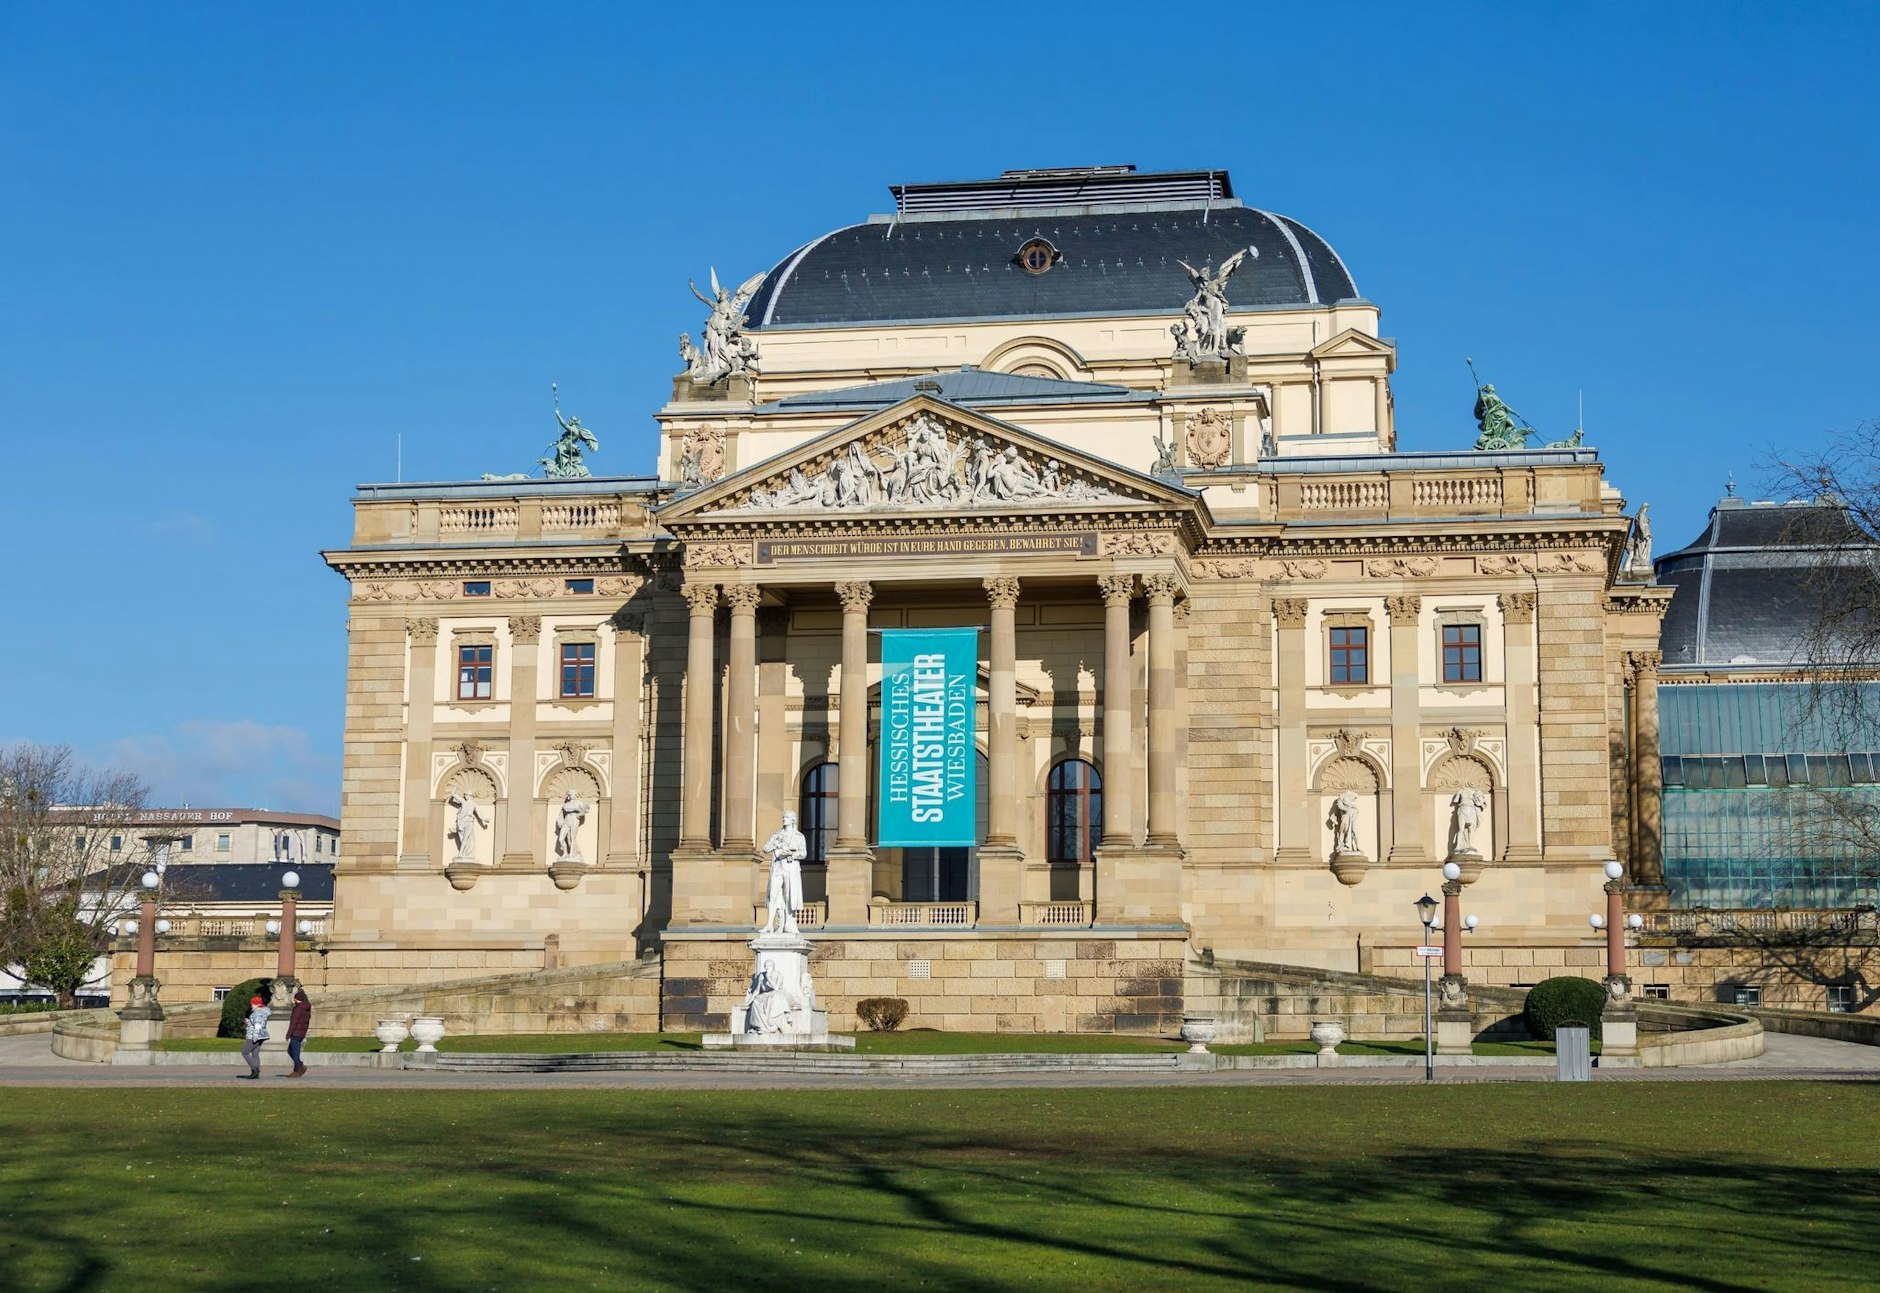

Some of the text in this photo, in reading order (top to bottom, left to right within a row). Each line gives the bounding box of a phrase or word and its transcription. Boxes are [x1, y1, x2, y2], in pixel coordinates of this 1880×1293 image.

[771, 545, 790, 555] DER
[791, 543, 848, 555] MENSCHHEIT
[850, 541, 882, 554] WÜRDE
[883, 542, 899, 553] IST
[900, 541, 910, 552] IN
[911, 541, 936, 552] EURE
[937, 540, 961, 552] HAND
[1010, 538, 1062, 550] BEWAHRET
[1063, 536, 1083, 548] SIE!
[890, 672, 910, 803] HESSISCHES
[911, 653, 946, 823] STAATSTHEATER
[946, 674, 967, 801] WIESBADEN
[139, 811, 202, 821] NASSAUER
[210, 811, 233, 820] HOF
